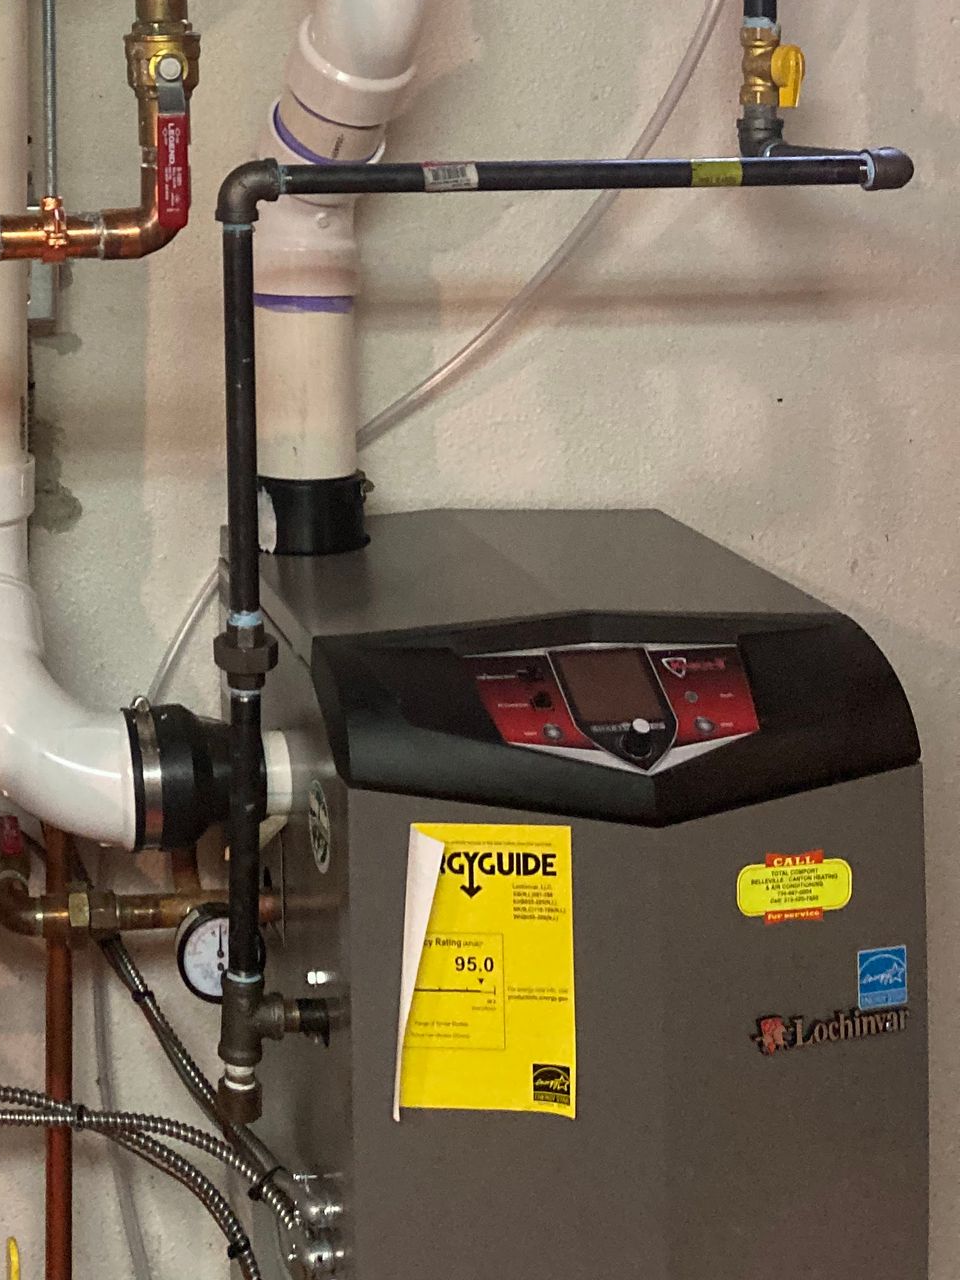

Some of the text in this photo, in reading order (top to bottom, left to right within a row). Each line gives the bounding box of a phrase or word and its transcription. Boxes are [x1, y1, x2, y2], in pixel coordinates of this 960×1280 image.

[167, 123, 176, 165] LEGEND
[773, 856, 815, 867] CALL
[751, 877, 784, 885] BELLEVILLE
[789, 875, 812, 883] CANTON
[782, 881, 824, 889] CONDITIONING
[784, 910, 820, 918] service
[435, 937, 462, 948] Rating
[455, 956, 494, 972] 95.0
[794, 1009, 910, 1045] Lochinvar
